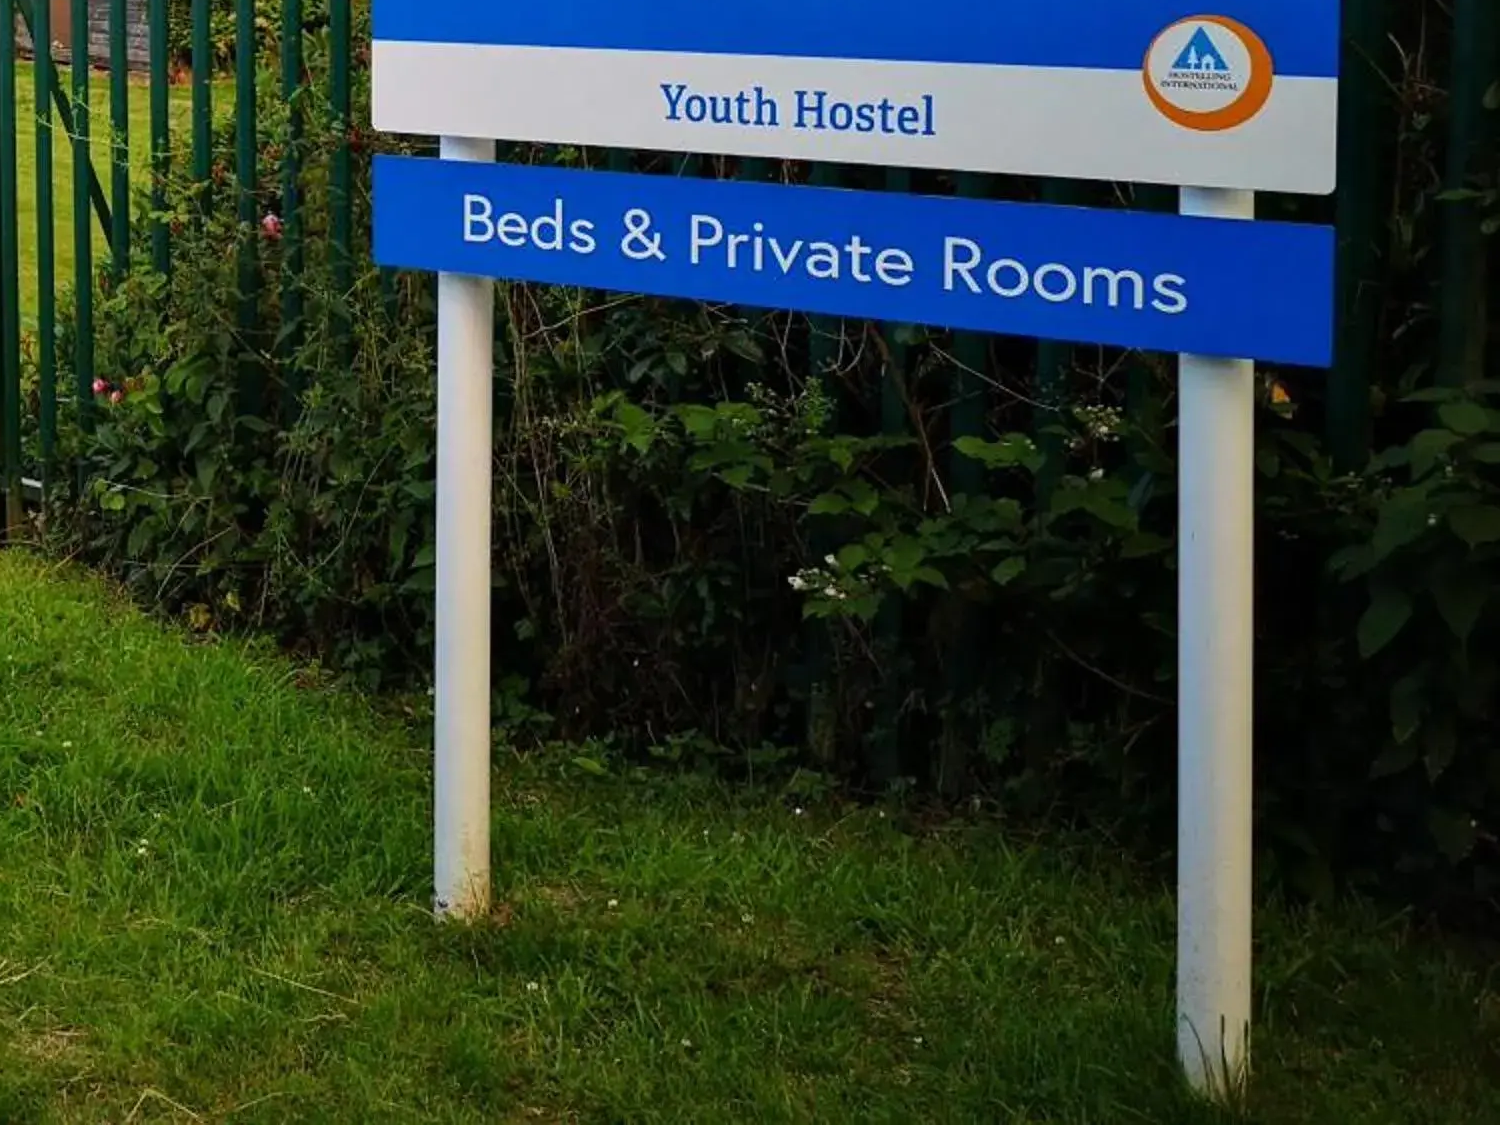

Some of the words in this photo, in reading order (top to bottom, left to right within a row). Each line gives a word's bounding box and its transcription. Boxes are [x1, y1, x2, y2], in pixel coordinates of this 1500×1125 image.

[1160, 81, 1238, 91] INTERNATIONAL
[1169, 72, 1231, 81] HOSTELLING
[660, 83, 779, 127] Youth
[794, 89, 937, 136] Hostel
[462, 193, 597, 254] Beds
[620, 208, 667, 262] &
[690, 213, 915, 287] Private
[943, 235, 1188, 314] Rooms
